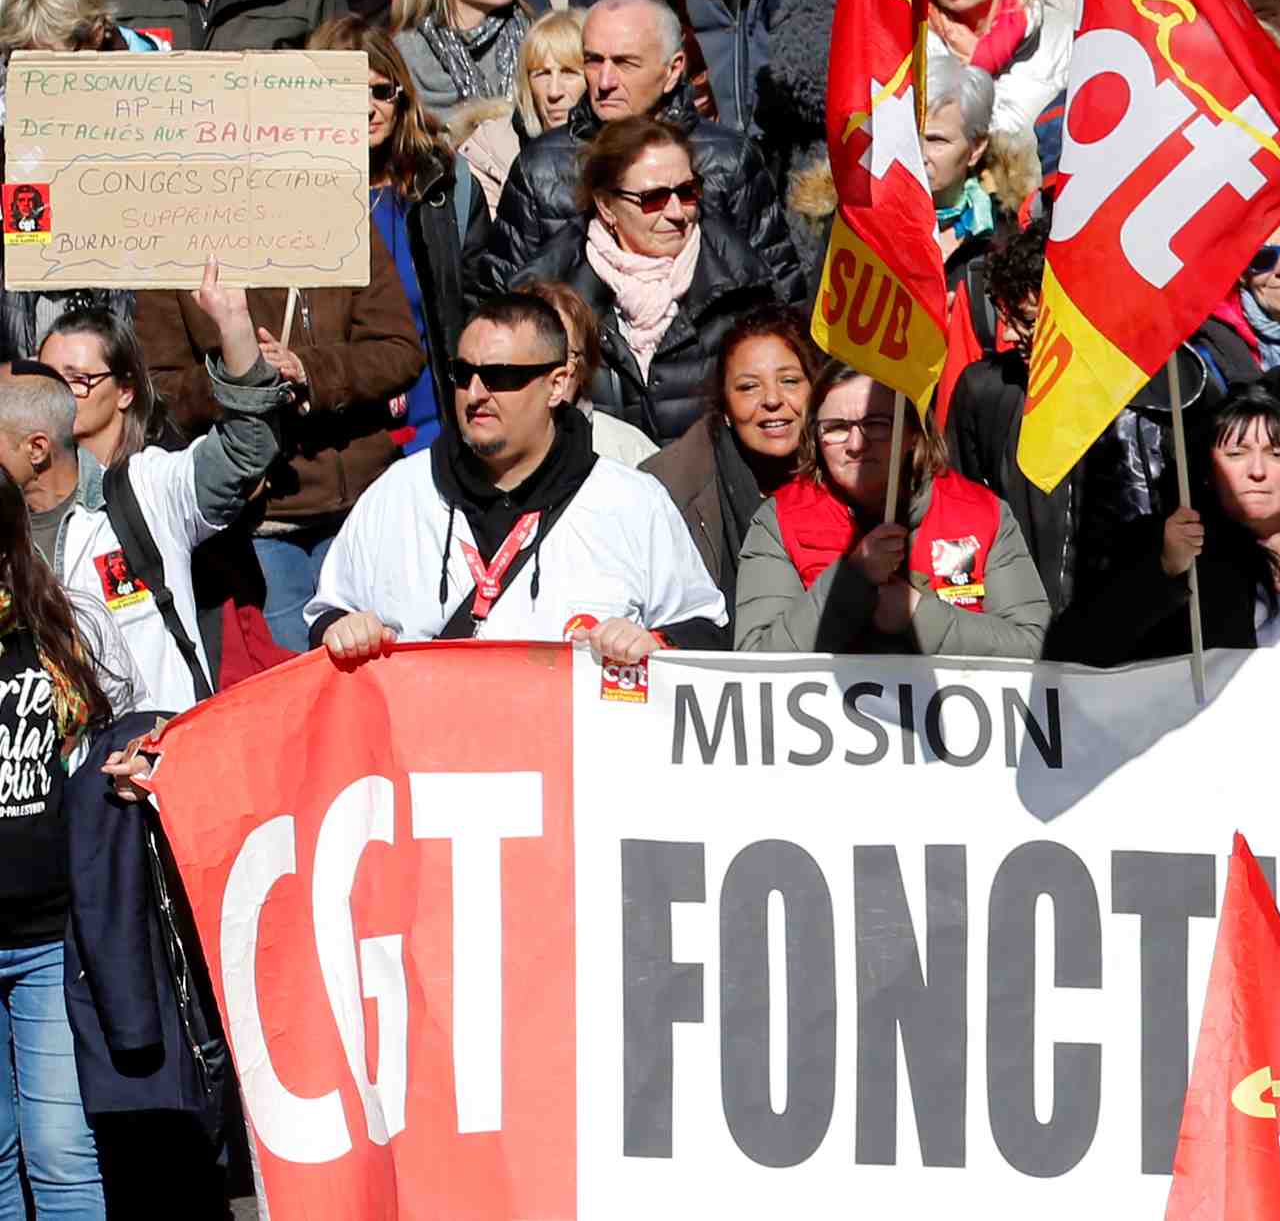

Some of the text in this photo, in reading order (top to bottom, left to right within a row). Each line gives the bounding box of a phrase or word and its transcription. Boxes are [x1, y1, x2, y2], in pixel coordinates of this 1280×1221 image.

[20, 69, 193, 96] PERSONNELS
[115, 97, 216, 119] AP-HM
[153, 125, 187, 141] AUX
[78, 164, 203, 196] CONGÉS
[602, 665, 649, 690] cgt
[671, 680, 1063, 769] MISSION
[221, 770, 544, 1165] CGT
